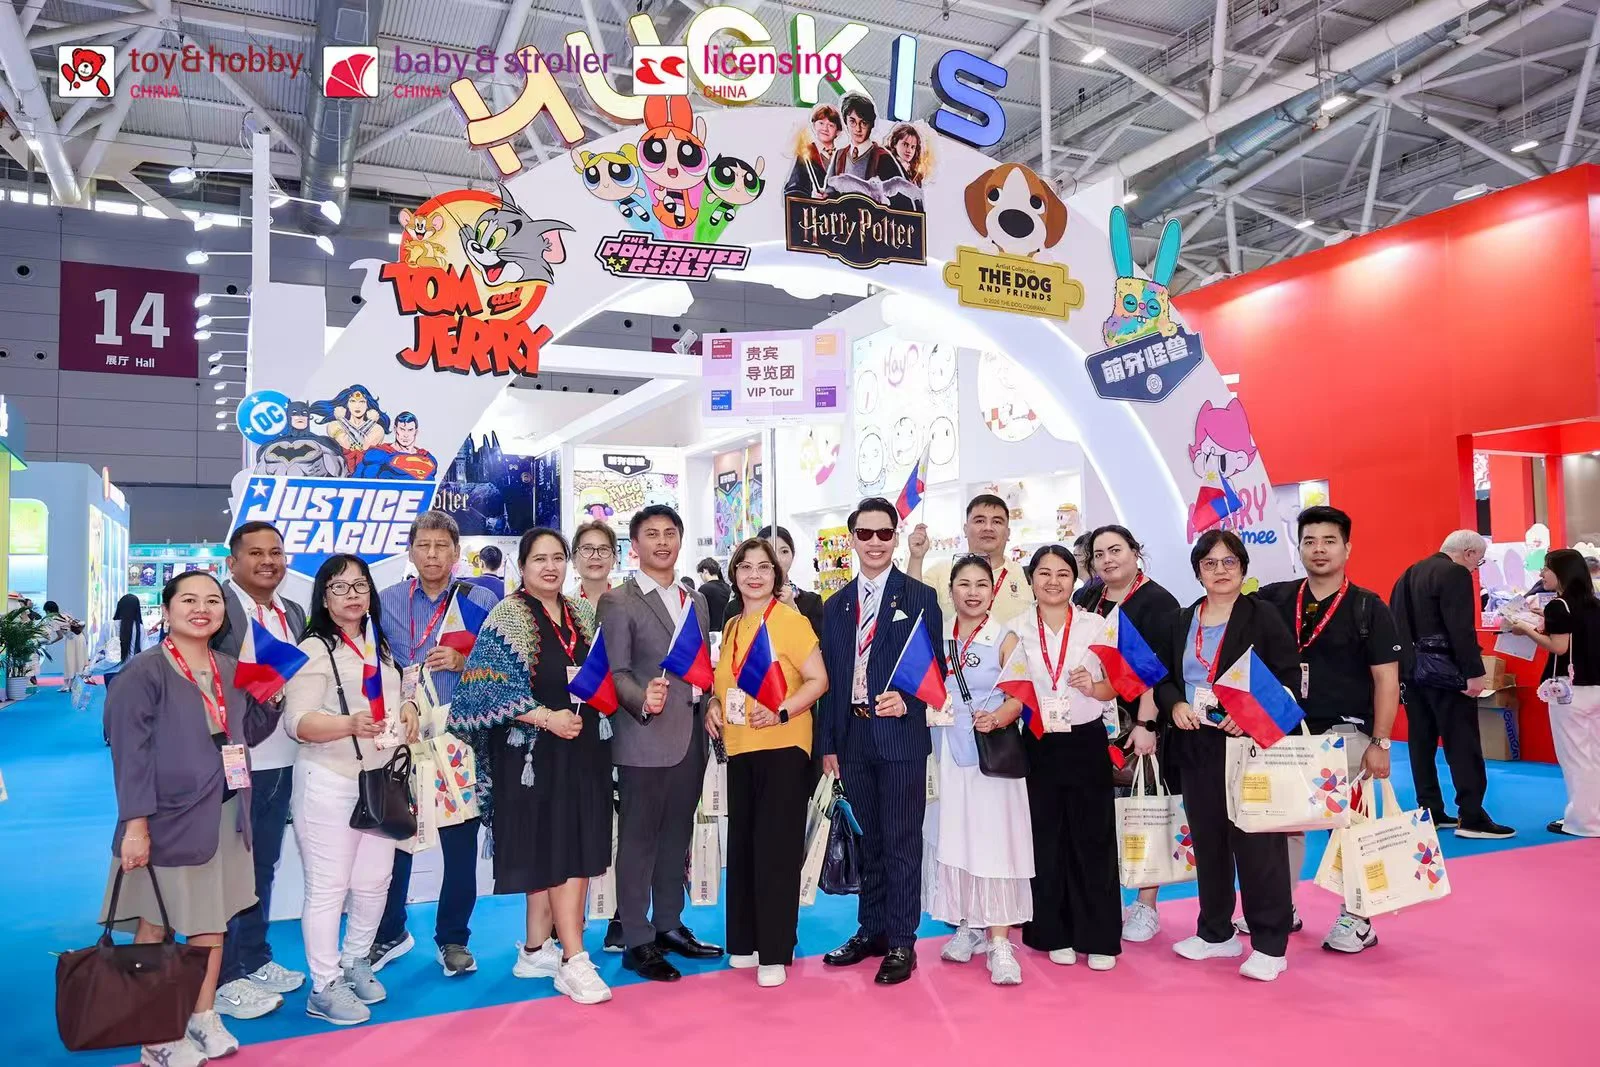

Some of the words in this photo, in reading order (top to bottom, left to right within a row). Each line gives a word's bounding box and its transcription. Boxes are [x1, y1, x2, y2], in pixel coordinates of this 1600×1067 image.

[623, 236, 646, 244] THE
[798, 205, 857, 247] Harry
[858, 207, 916, 254] Potter
[602, 242, 745, 265] POWERPUFF
[627, 258, 710, 277] GIRLS
[1011, 265, 1036, 274] Collection
[378, 261, 484, 316] TOM
[487, 287, 523, 313] and
[978, 267, 1011, 287] THE
[1014, 272, 1053, 293] DOG
[978, 284, 1001, 294] AND
[1006, 288, 1052, 302] FRIENDS
[94, 288, 170, 349] 14
[396, 315, 554, 378] JERRY
[746, 346, 779, 362] 贵宾
[105, 354, 130, 367] 展厅
[135, 357, 155, 368] Hall
[1100, 334, 1189, 384] 萌牙怪兽
[746, 365, 795, 381] 导览团
[746, 387, 767, 398] VIP
[769, 386, 794, 397] Tour
[253, 405, 284, 432] DC
[246, 477, 425, 522] JUSTICE
[433, 488, 470, 513] otter
